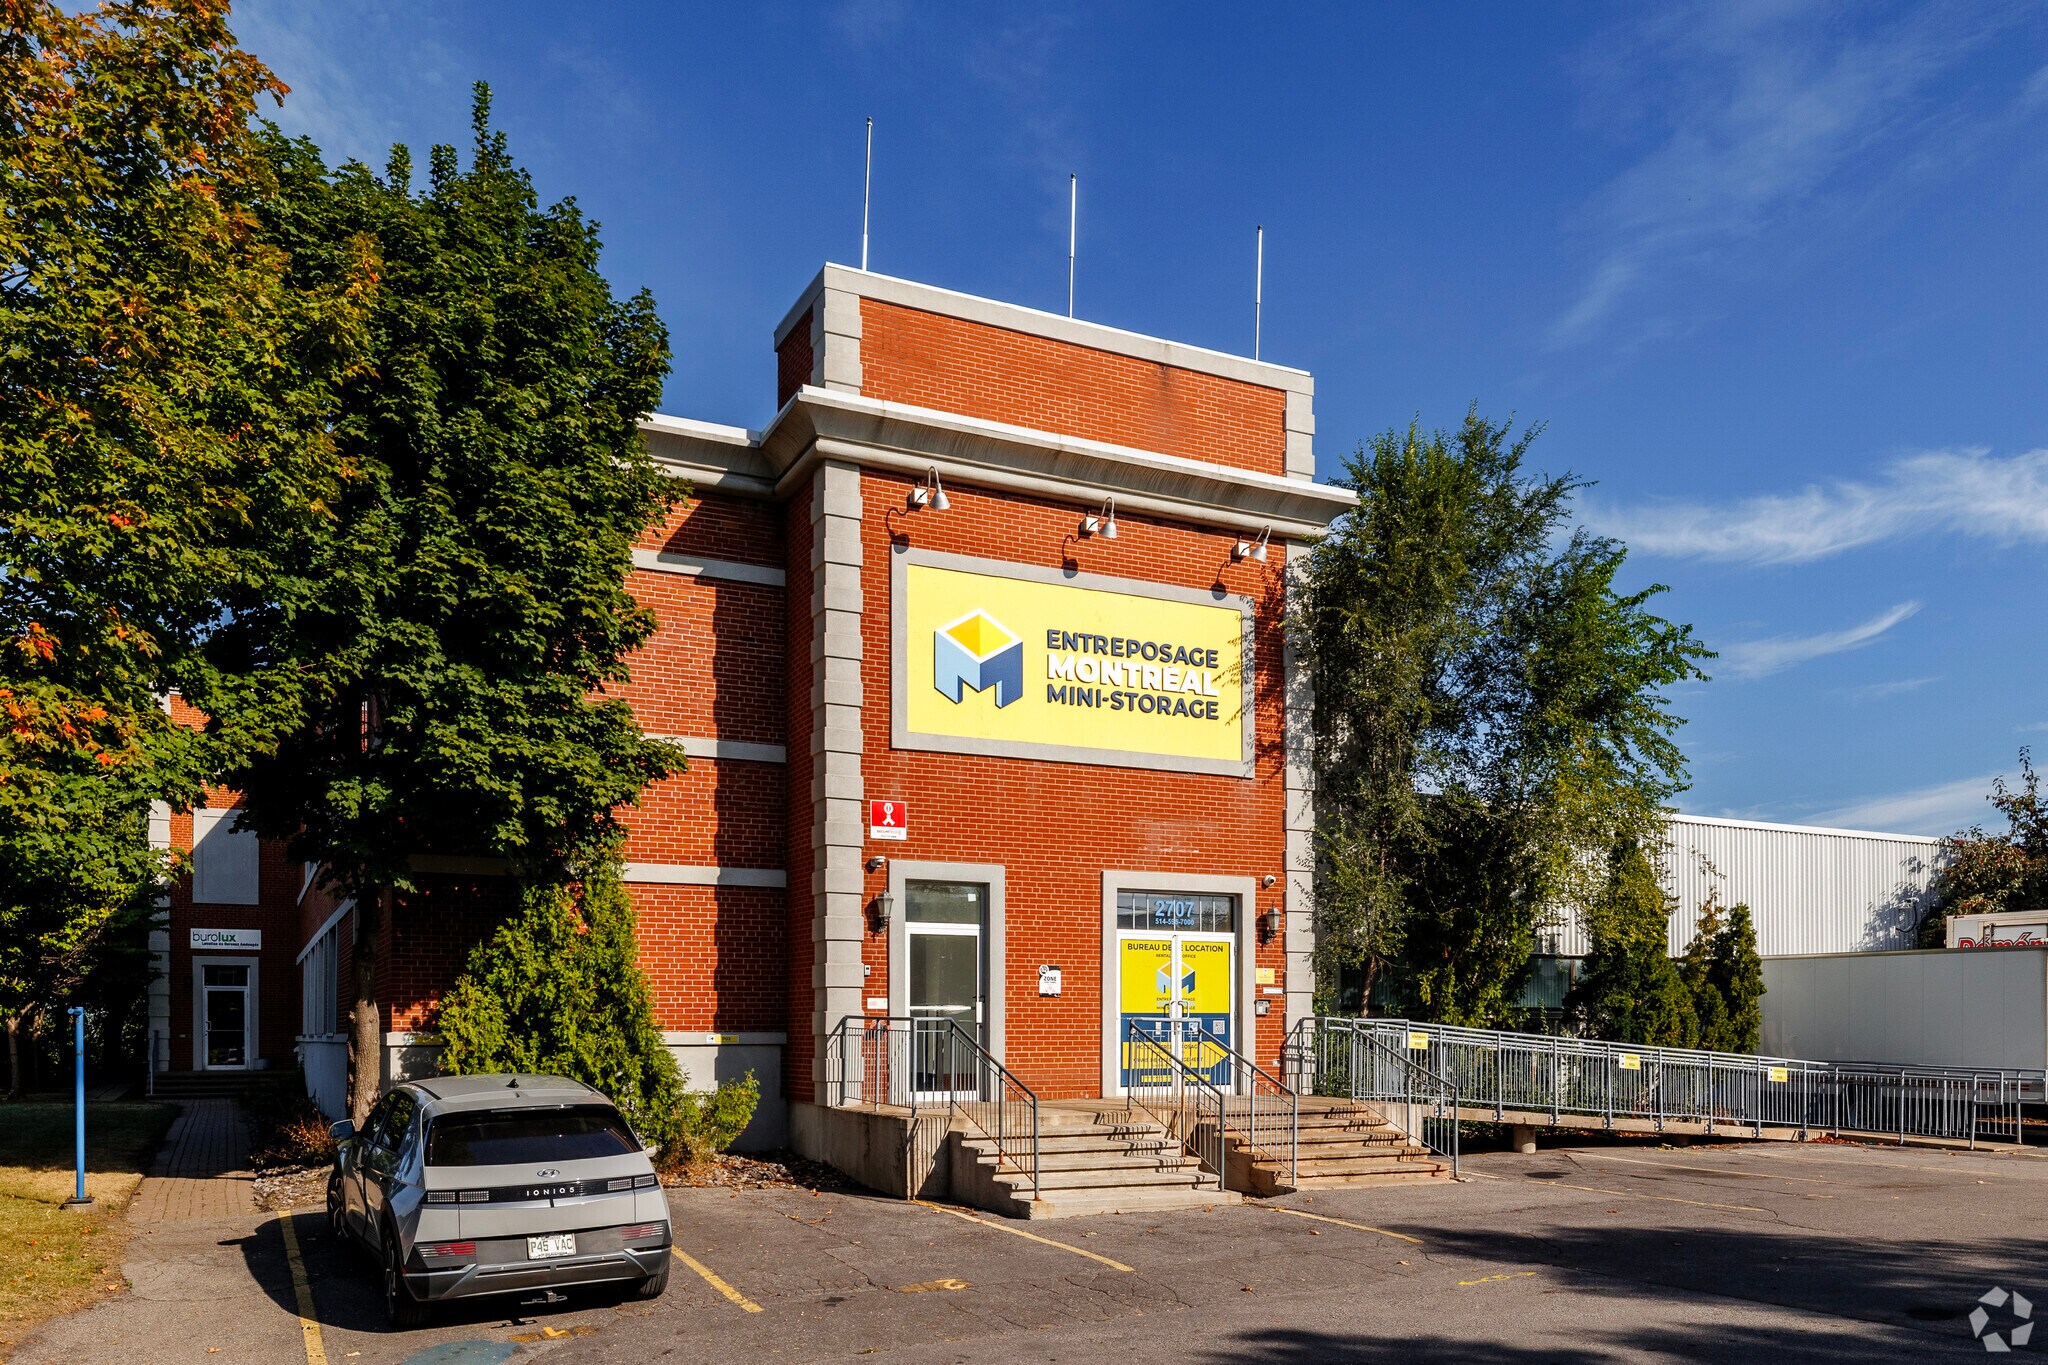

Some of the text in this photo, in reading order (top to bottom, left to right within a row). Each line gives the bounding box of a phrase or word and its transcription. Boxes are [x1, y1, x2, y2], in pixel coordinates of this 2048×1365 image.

[1046, 629, 1219, 669] ENTREPOSAGE
[1046, 653, 1220, 697] MONTRÉAL
[1046, 684, 1220, 720] MINI-STORAGE
[1155, 900, 1195, 917] 2707
[192, 931, 236, 942] burolux
[1127, 943, 1160, 951] BUREAU
[1185, 945, 1223, 953] LOCATION
[526, 1188, 566, 1197] IONIQ
[530, 1238, 573, 1254] P45 VAC
